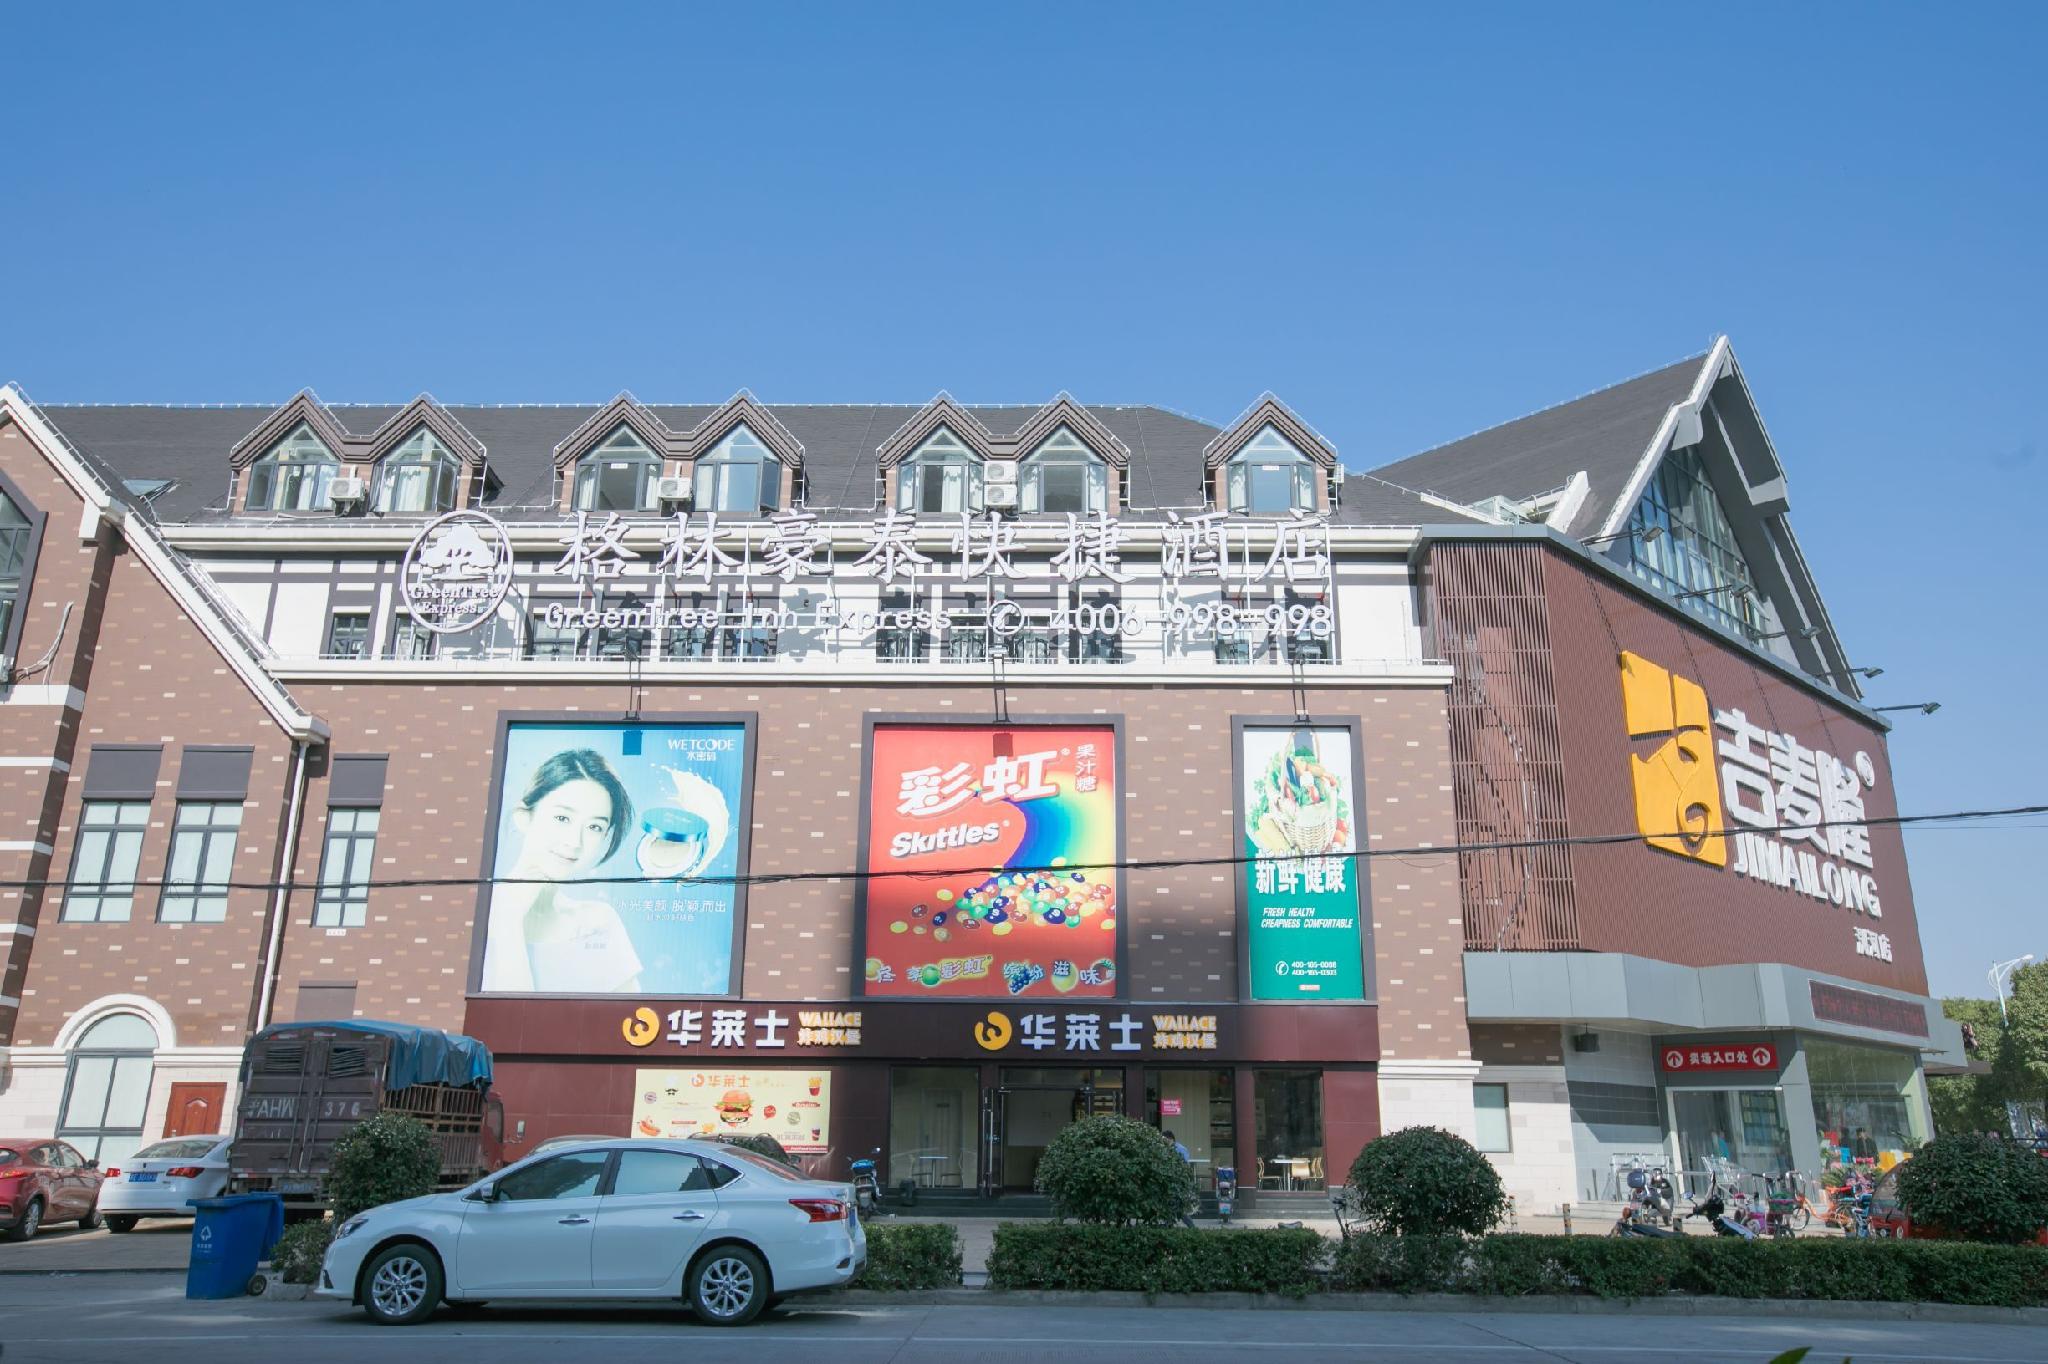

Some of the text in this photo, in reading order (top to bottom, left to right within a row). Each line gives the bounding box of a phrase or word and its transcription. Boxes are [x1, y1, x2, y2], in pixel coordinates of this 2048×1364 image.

[553, 508, 1330, 584] 格林豪泰快捷酒店
[815, 603, 952, 634] Express
[1049, 603, 1334, 636] 4006-998-998
[667, 738, 735, 751] WETCODE
[897, 751, 1058, 815] 彩虹
[1075, 743, 1097, 792] 果汁糖
[890, 822, 1000, 857] Skittles
[1254, 848, 1347, 894] 新鲜健康
[1734, 827, 1882, 918] JIMAILONG
[1261, 918, 1354, 928] CHEAPNESS COMFORTABLE
[1263, 907, 1316, 917] FRESH HEALTH
[667, 1009, 789, 1047] 华莱士
[798, 1011, 862, 1027] WALLACE
[1020, 1013, 1144, 1050] 华莱士
[1151, 1014, 1217, 1031] WALLACE
[708, 1074, 750, 1088] 华莱士
